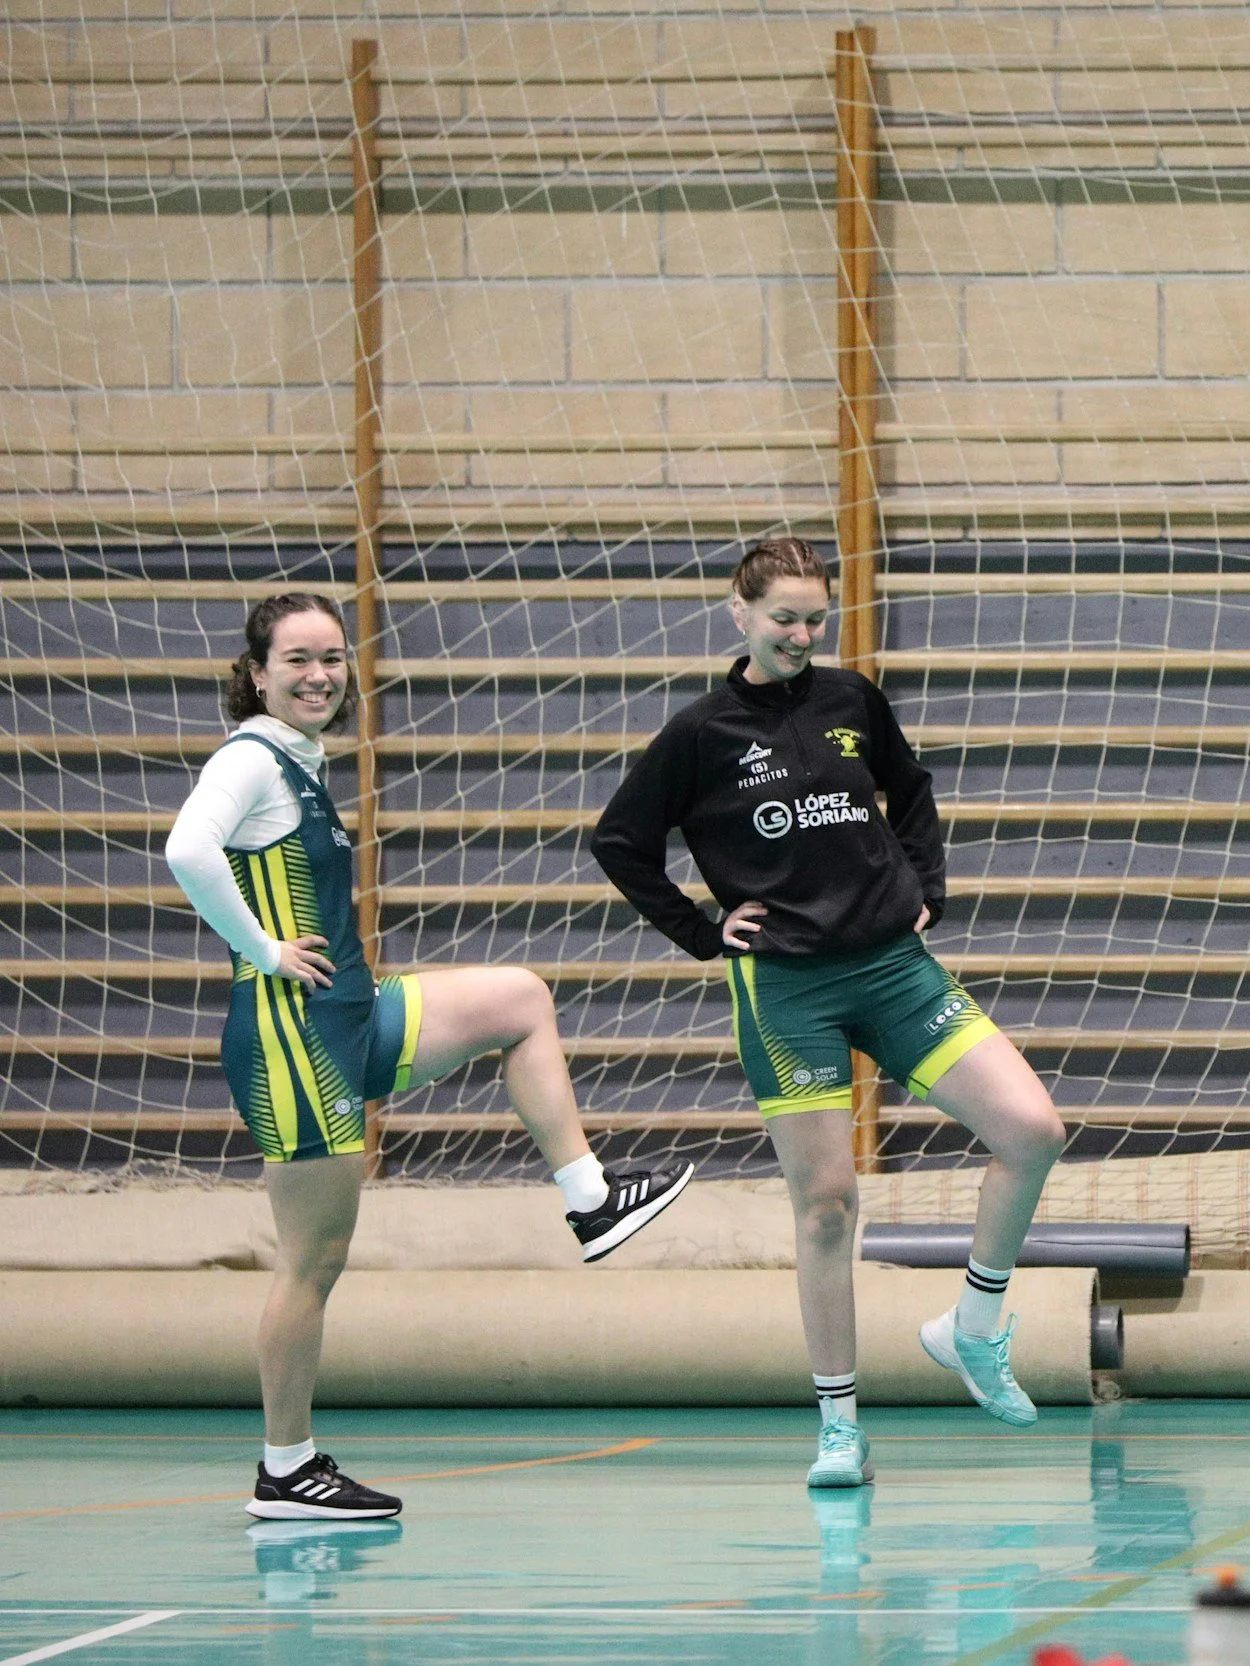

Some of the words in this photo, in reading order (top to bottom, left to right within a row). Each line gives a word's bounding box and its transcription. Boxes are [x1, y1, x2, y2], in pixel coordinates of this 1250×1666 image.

[794, 791, 851, 814] LÓPEZ
[797, 807, 870, 829] SORIANO
[928, 1001, 962, 1031] LOCO
